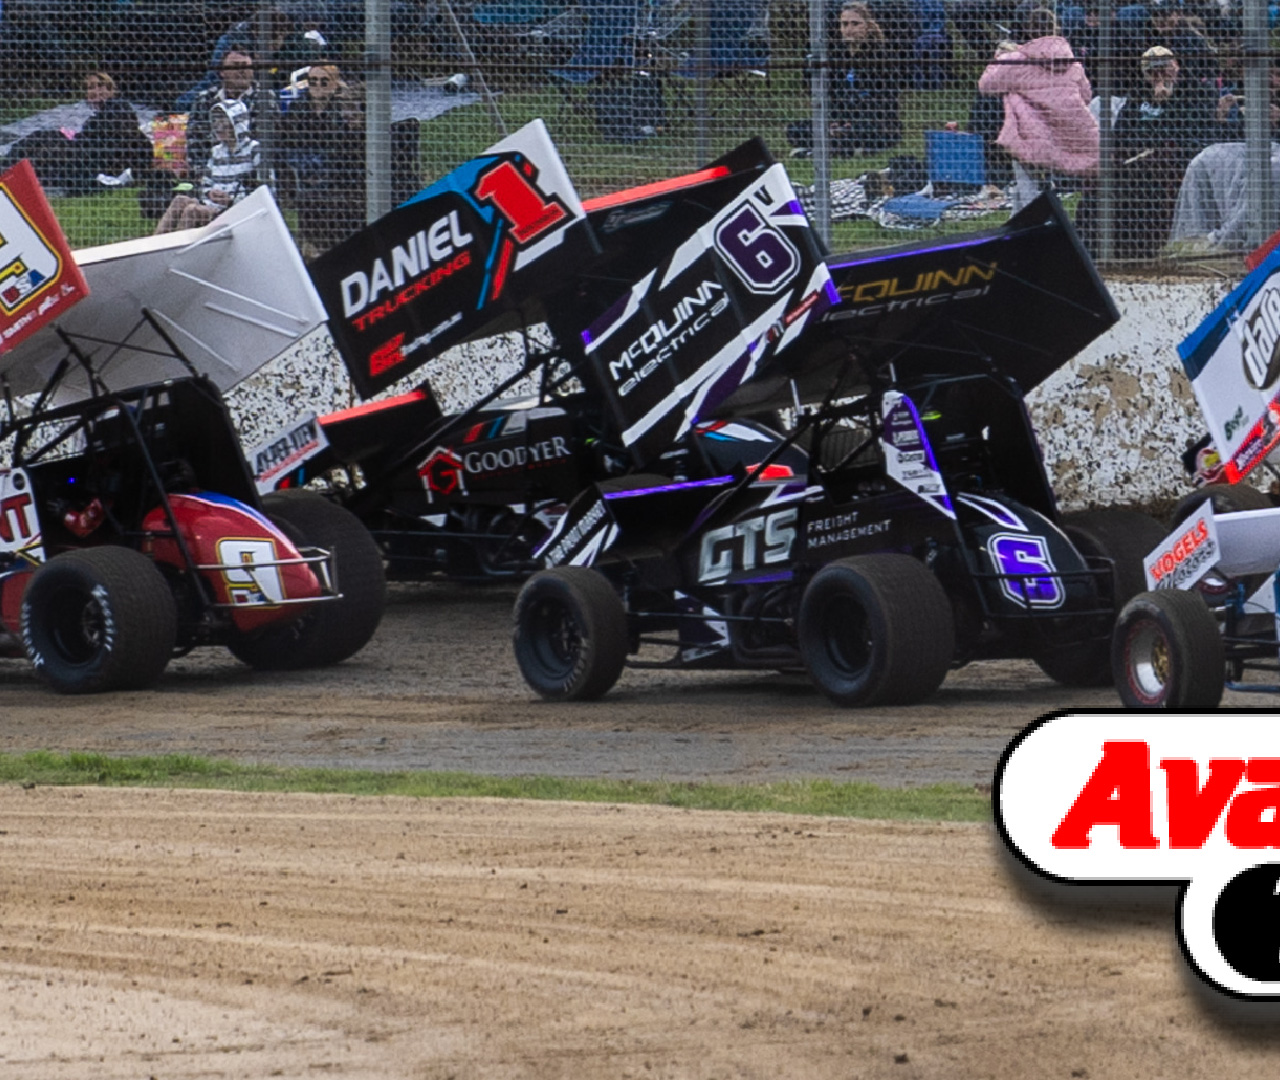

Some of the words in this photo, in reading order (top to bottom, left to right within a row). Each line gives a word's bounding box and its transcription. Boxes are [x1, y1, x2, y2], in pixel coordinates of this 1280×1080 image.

[474, 160, 568, 245] 1
[754, 184, 775, 207] V
[340, 210, 474, 319] DANIEL
[712, 199, 802, 296] 6
[834, 261, 998, 303] cQUINN
[351, 250, 472, 331] TRUCKING
[821, 285, 991, 323] lectrical
[618, 291, 733, 397] electrical
[698, 507, 799, 586] GTS
[807, 512, 859, 534] FREIGHT
[807, 519, 892, 550] MANAGEMENT
[1149, 519, 1209, 583] VOGELS
